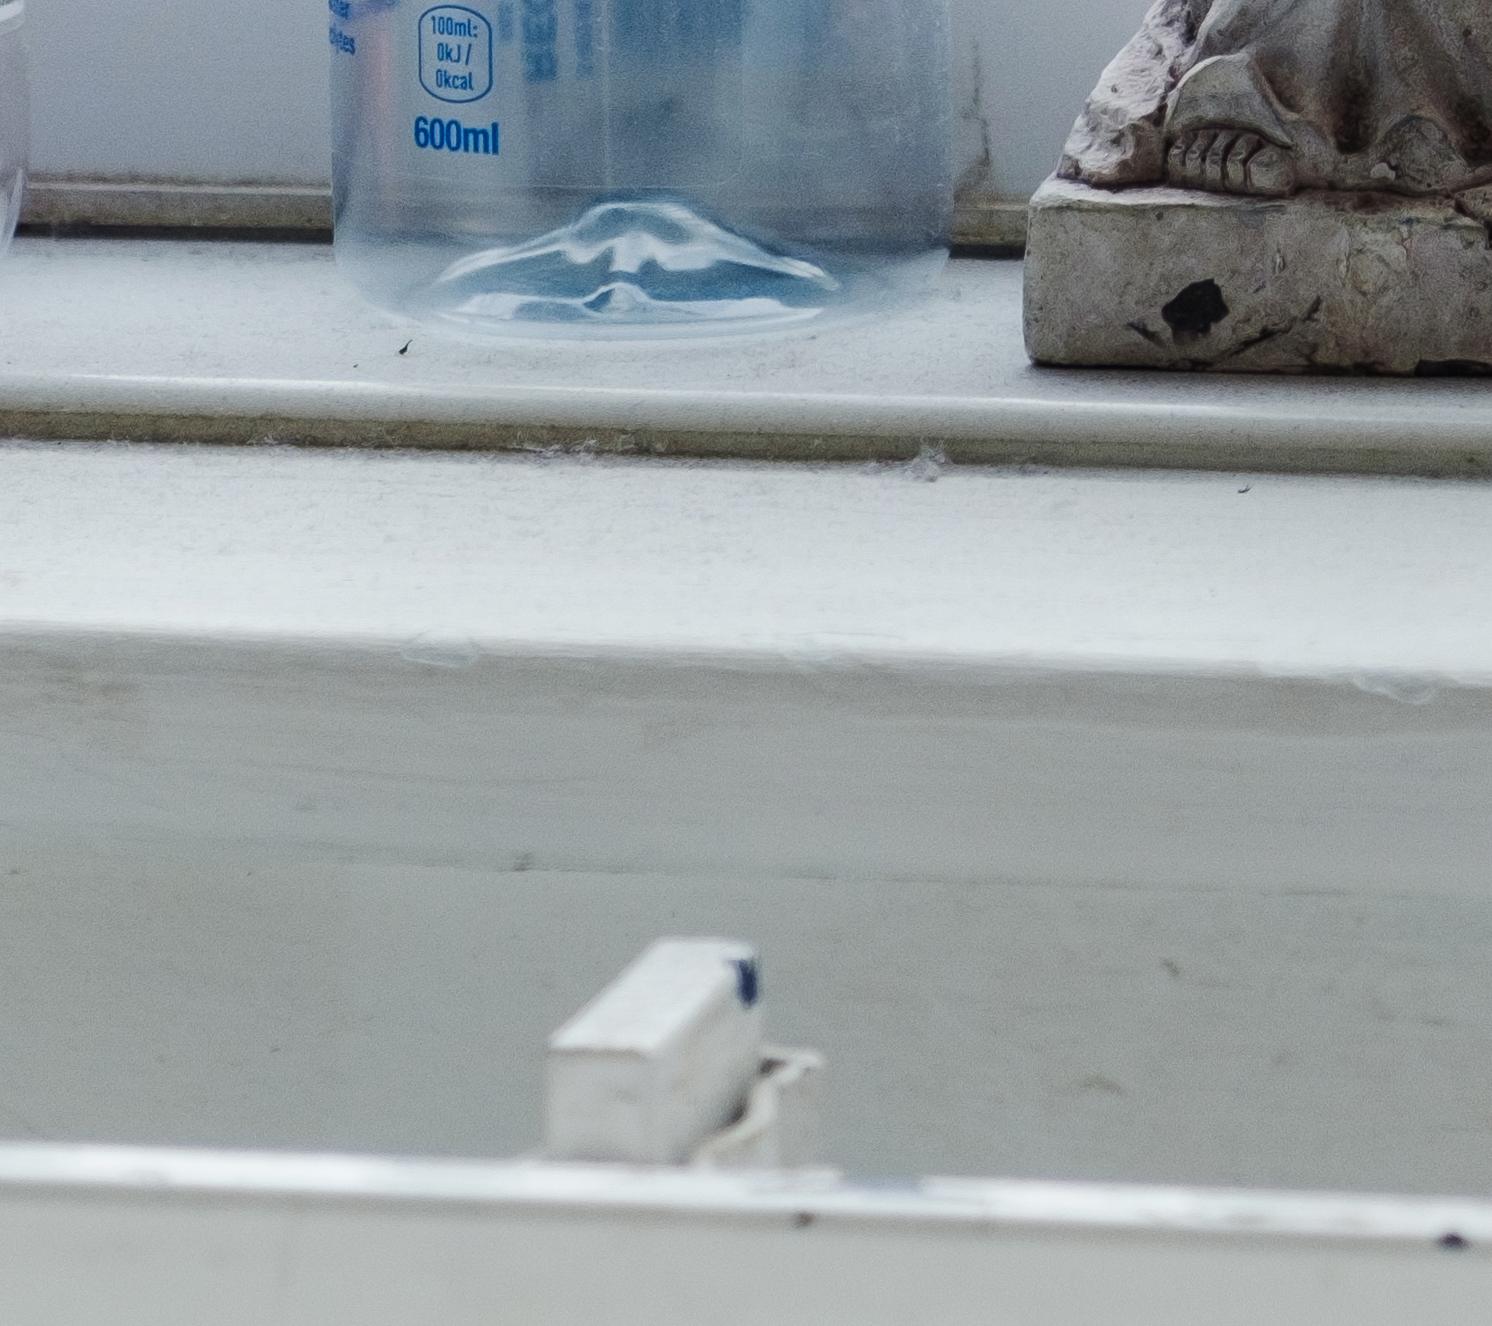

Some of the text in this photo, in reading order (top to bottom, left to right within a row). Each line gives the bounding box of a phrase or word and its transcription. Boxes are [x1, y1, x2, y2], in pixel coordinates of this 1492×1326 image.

[430, 15, 479, 39] 100ml:
[436, 41, 462, 64] 0kJ
[434, 68, 474, 92] 0kcal
[413, 116, 499, 156] 600ml
